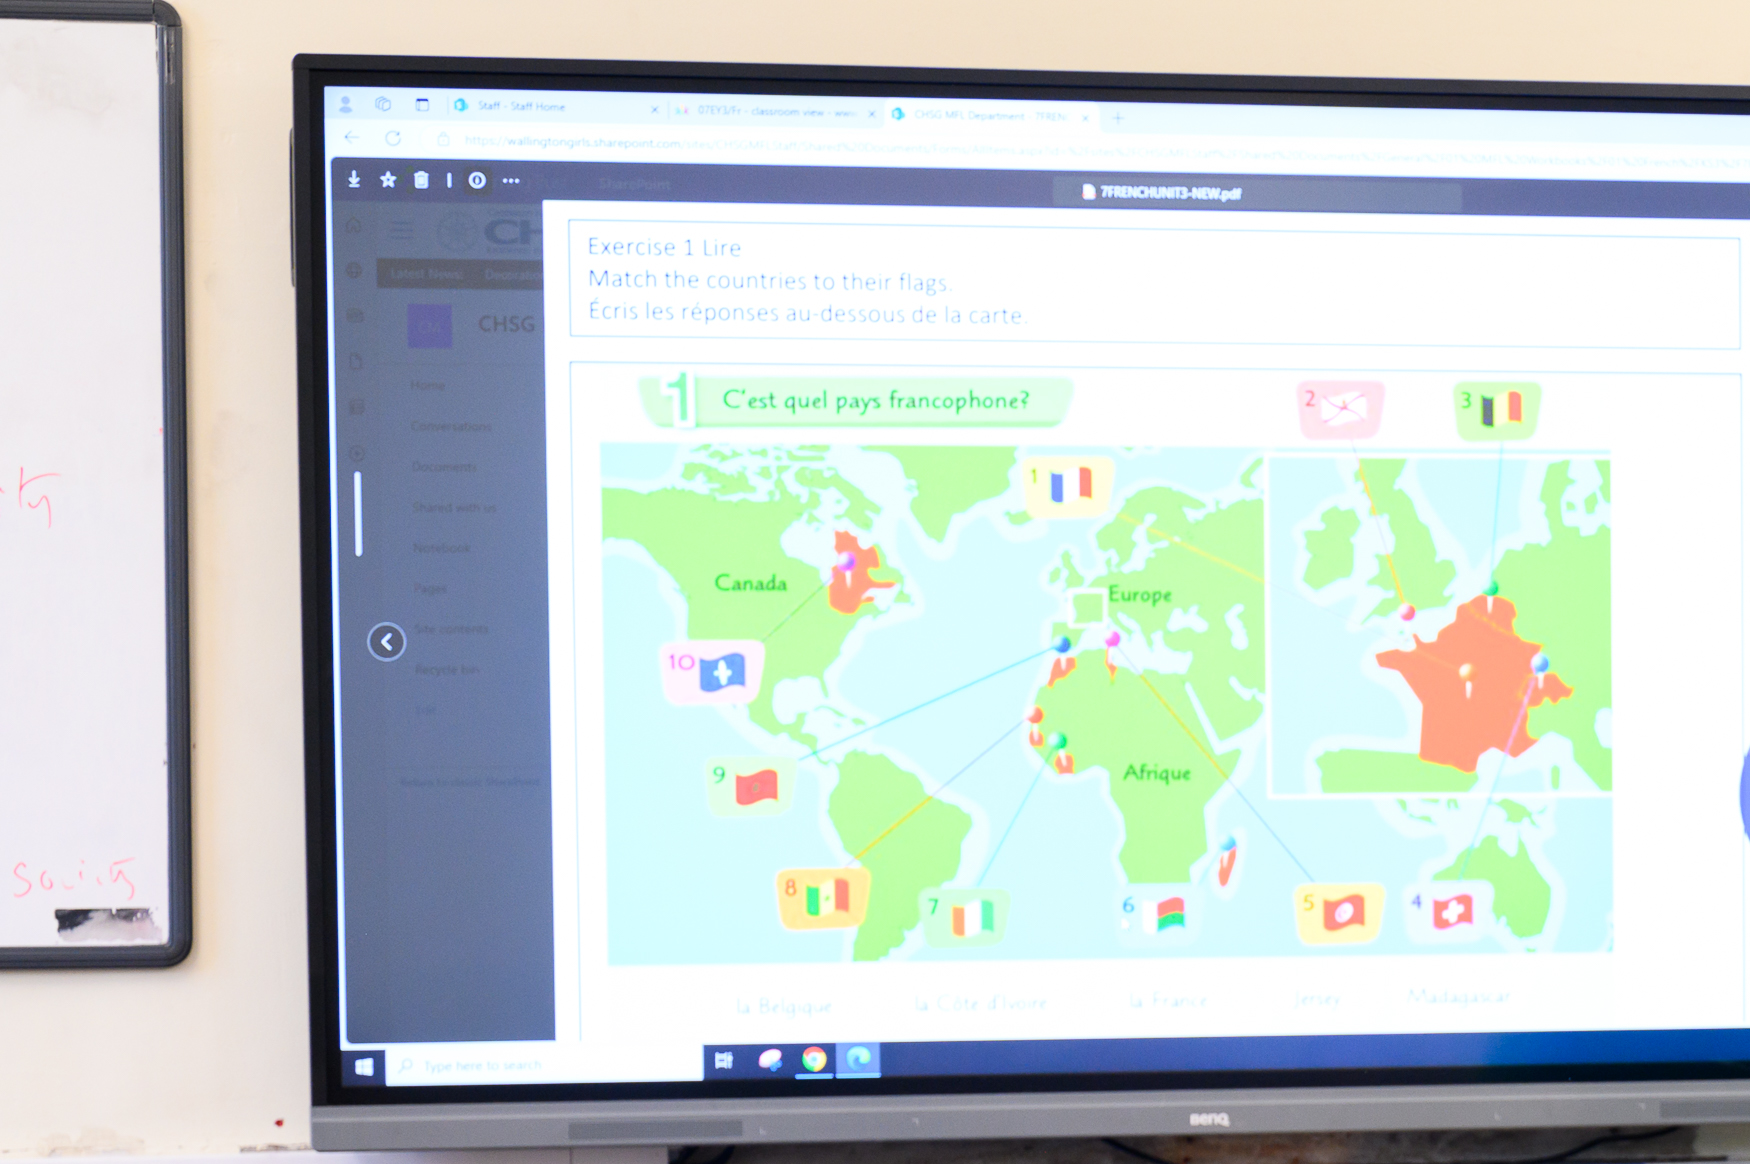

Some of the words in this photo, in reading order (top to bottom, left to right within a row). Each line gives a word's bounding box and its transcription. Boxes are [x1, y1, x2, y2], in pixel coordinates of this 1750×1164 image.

[478, 100, 502, 113] Staff
[511, 101, 534, 113] Staff
[536, 102, 567, 113] Home
[751, 106, 800, 118] classroom
[802, 108, 826, 119] view
[969, 110, 1026, 125] Department
[1100, 184, 1243, 203] 7FRENCHUNIT3-NEW.pdf
[588, 236, 677, 257] Exercise
[685, 238, 694, 257] 1
[703, 238, 743, 258] Lire
[588, 268, 658, 289] Match
[665, 269, 700, 290] the
[706, 271, 808, 291] countries
[814, 273, 836, 291] to
[842, 272, 892, 292] their
[900, 271, 954, 297] flags.
[588, 296, 639, 321] Écris
[645, 301, 675, 321] les
[682, 301, 781, 326] réponses
[785, 303, 906, 325] au-dessous
[912, 304, 938, 324] de
[944, 304, 962, 324] la
[968, 307, 1026, 326] carte.
[479, 314, 537, 333] CHSG
[664, 370, 691, 423] 1
[721, 388, 778, 411] C'est
[783, 388, 829, 416] quel
[835, 391, 883, 417] pays
[887, 388, 1031, 416] francophone?
[1304, 389, 1316, 407] 2
[1460, 391, 1472, 409] 3
[714, 571, 789, 594] Canada
[1106, 582, 1172, 609] Europe
[668, 653, 696, 671] 10
[713, 766, 726, 785] 9
[1123, 762, 1191, 786] Afrique
[784, 878, 798, 898] 8
[925, 898, 939, 916] 7
[1122, 896, 1135, 914] 6
[1303, 893, 1315, 912] 5
[1410, 892, 1423, 911] 4
[914, 993, 929, 1012] la
[936, 993, 980, 1013] Côte
[987, 993, 1049, 1012] d'Ivoire
[1129, 992, 1144, 1009] la
[1151, 990, 1208, 1009] France
[1406, 986, 1512, 1011] Madagascar
[736, 996, 751, 1015] la
[758, 996, 833, 1021] Belgique
[424, 1060, 453, 1075] Type
[456, 1061, 483, 1072] here
[486, 1061, 500, 1072] to
[503, 1060, 542, 1072] search
